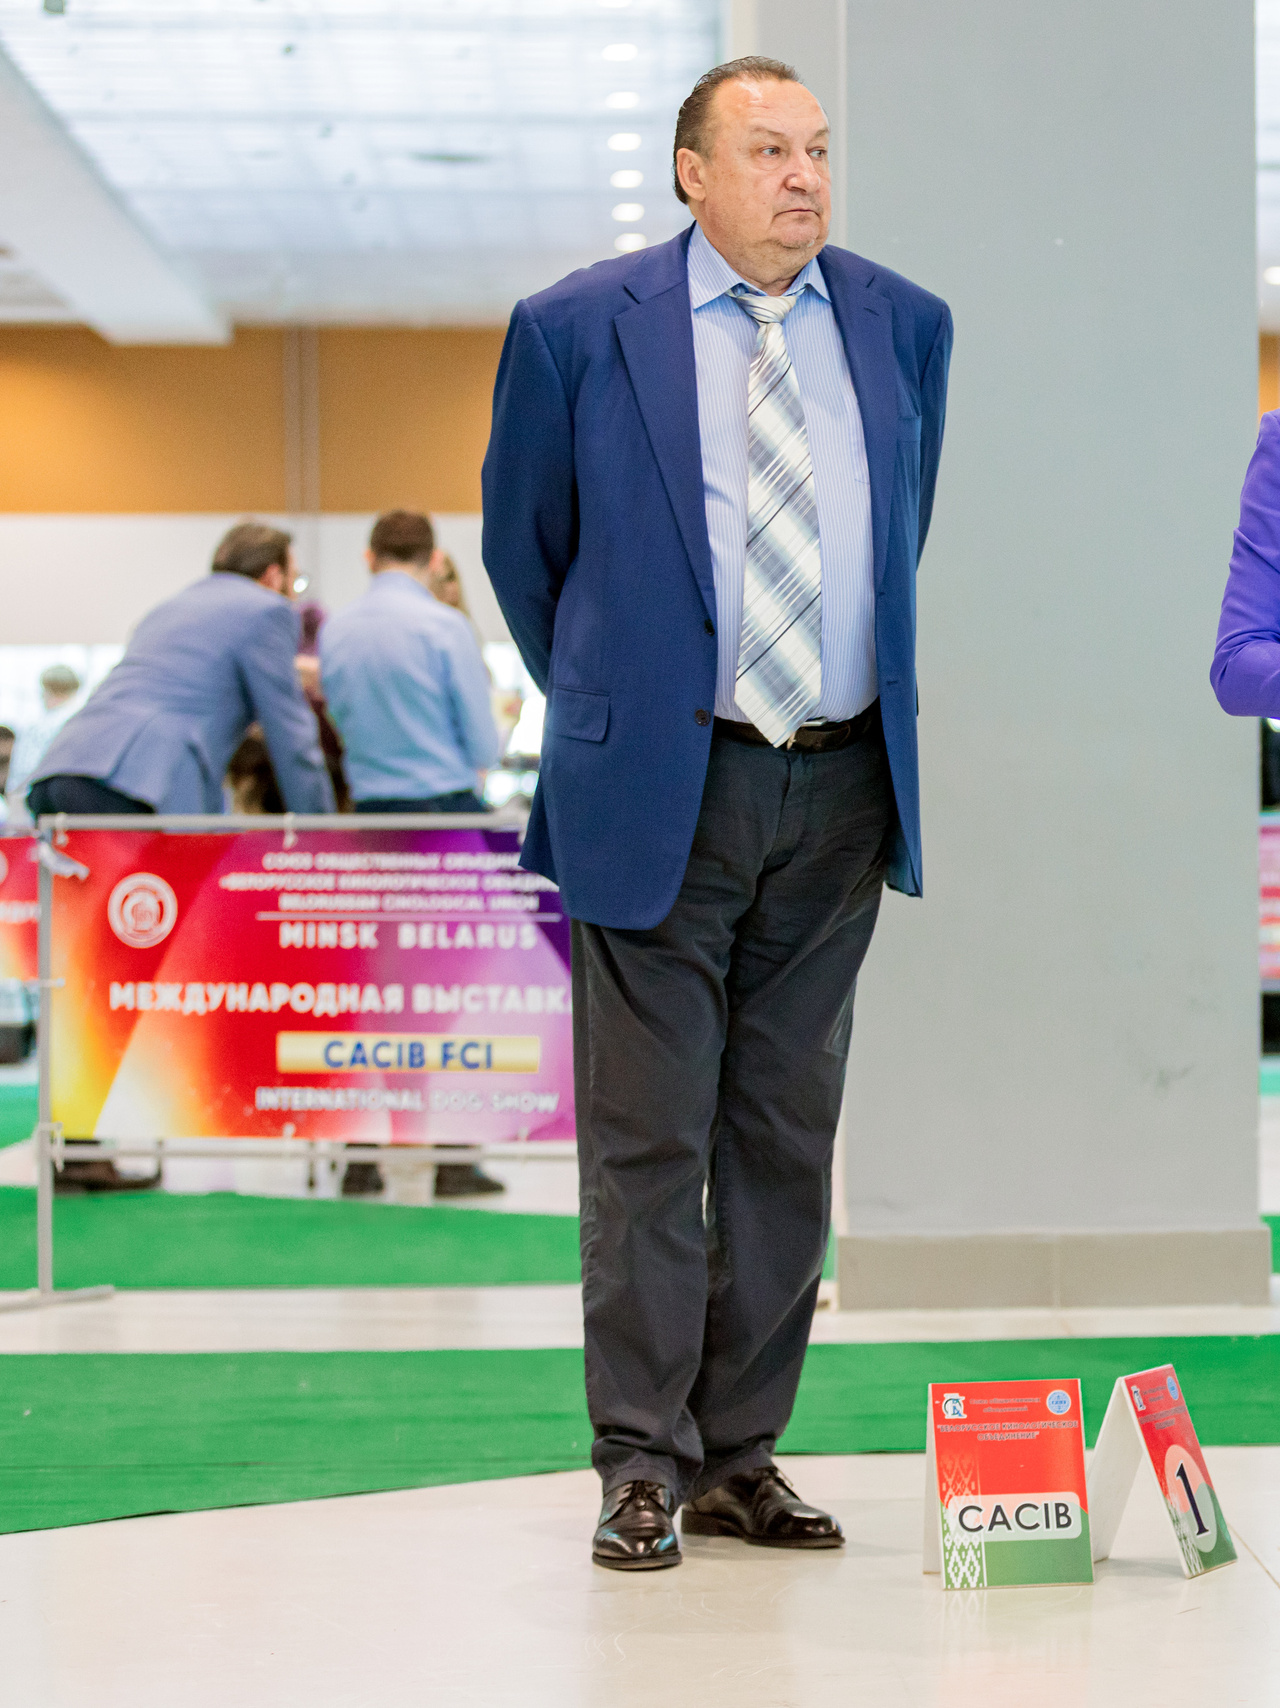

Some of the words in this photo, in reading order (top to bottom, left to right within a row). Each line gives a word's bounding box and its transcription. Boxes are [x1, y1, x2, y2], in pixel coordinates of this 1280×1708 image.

[279, 921, 378, 949] MINSK
[398, 921, 538, 949] BELARUS
[110, 982, 404, 1016] МЕЖДУНАРОДНАЯ
[412, 984, 572, 1013] ВЫСТАВК
[324, 1041, 426, 1069] CACIB
[440, 1042, 492, 1070] FCI
[255, 1086, 422, 1110] INTERNATIONAL
[429, 1087, 484, 1112] DOG
[491, 1089, 559, 1114] SHOW
[1175, 1459, 1209, 1537] 1
[958, 1502, 1072, 1532] CACIB
